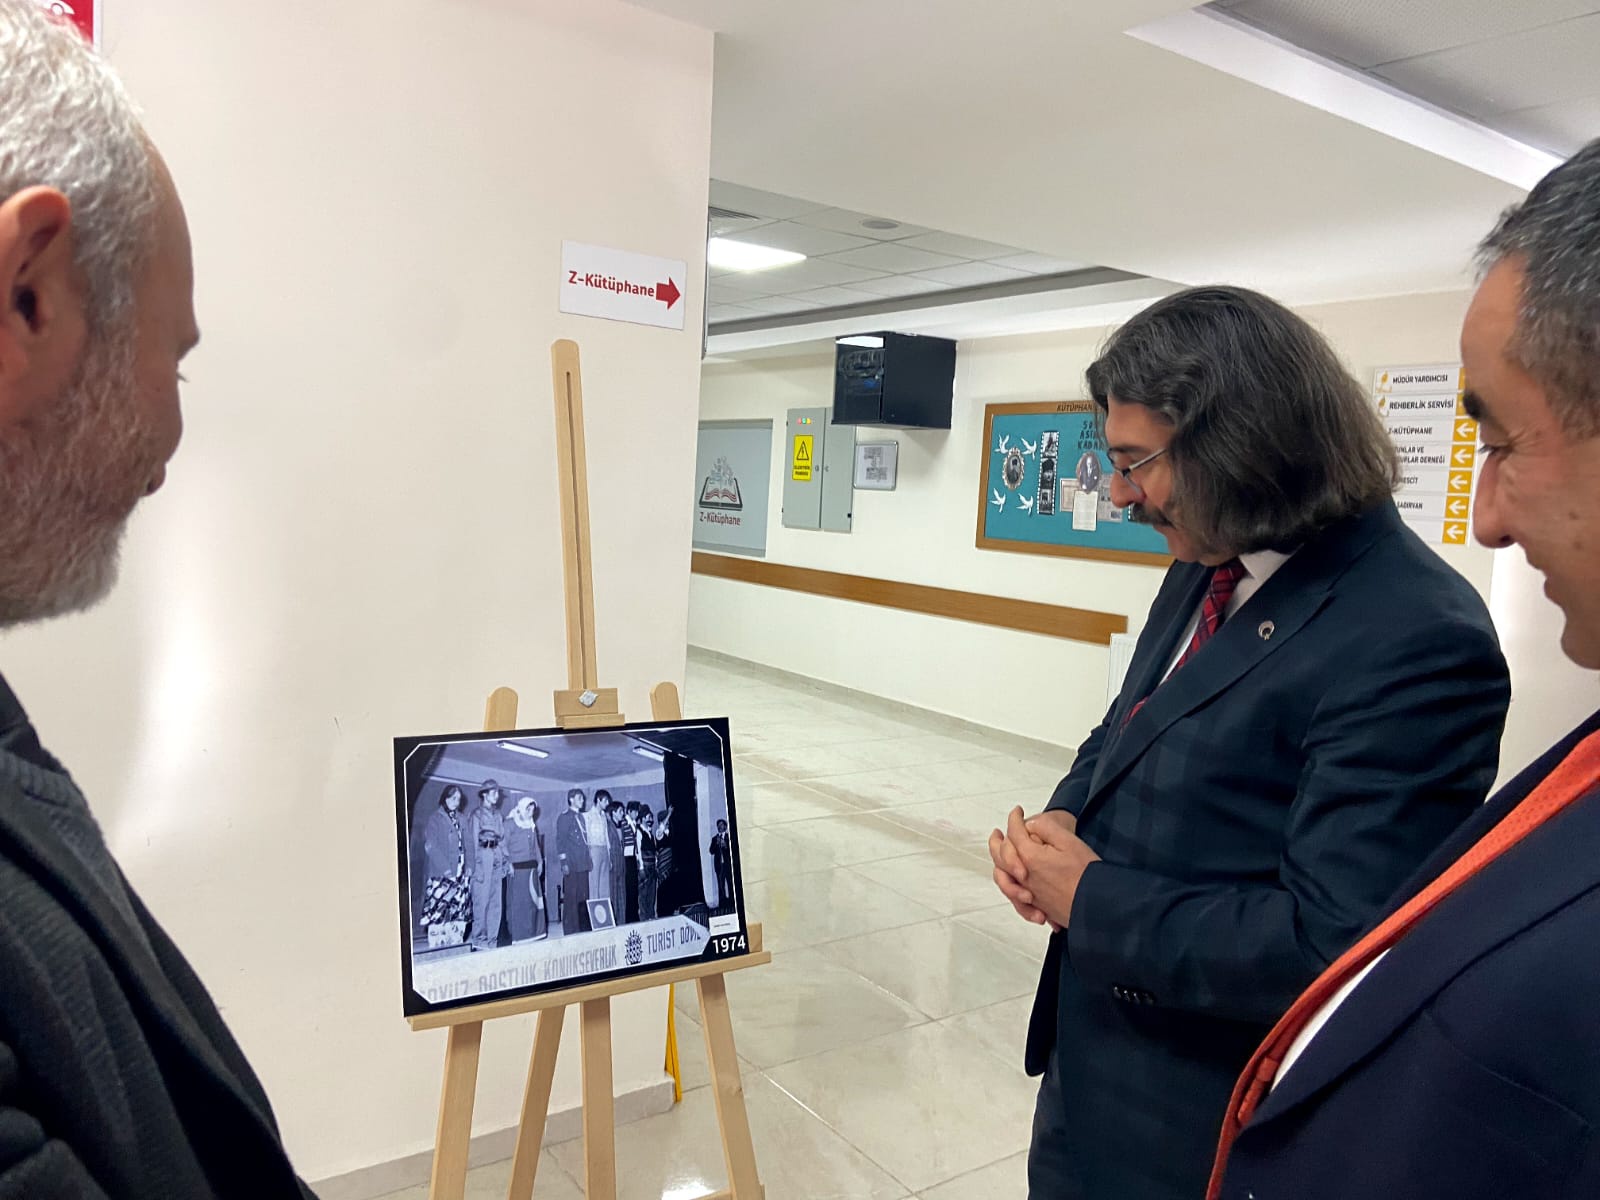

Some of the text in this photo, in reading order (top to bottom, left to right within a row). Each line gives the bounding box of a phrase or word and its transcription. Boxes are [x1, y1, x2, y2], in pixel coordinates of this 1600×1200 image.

[568, 270, 655, 297] Z-Kütüphane
[699, 511, 742, 526] Z-Kütüphane
[712, 934, 747, 954] 1974
